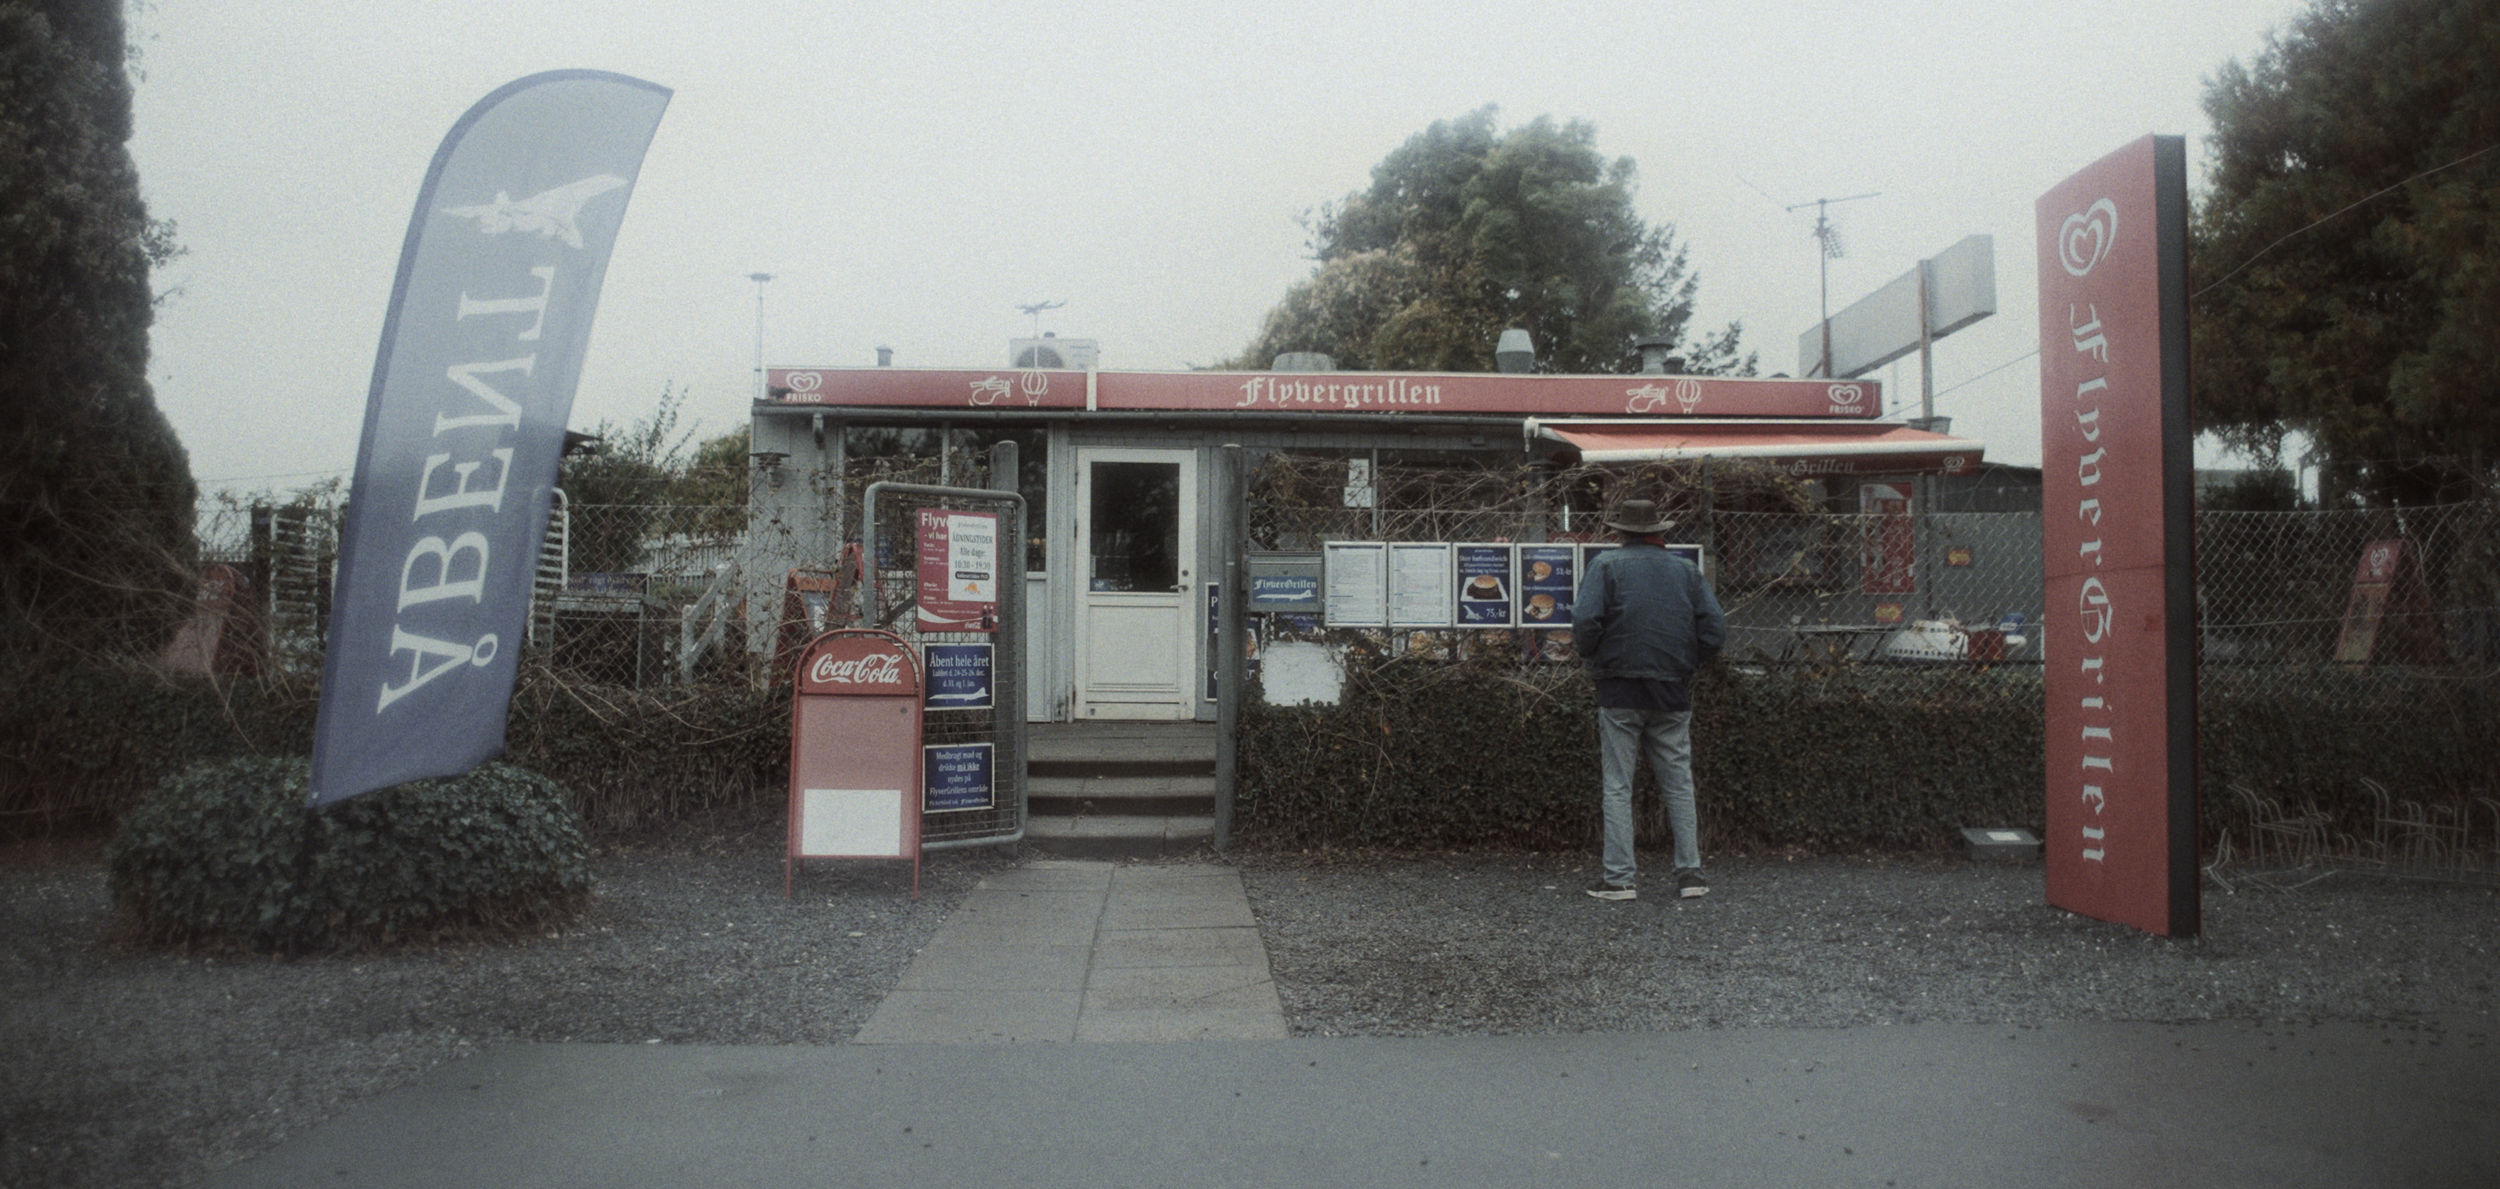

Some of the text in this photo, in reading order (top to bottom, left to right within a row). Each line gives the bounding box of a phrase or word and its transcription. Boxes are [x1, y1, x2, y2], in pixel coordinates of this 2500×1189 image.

[786, 393, 822, 403] FRISKO
[1236, 376, 1441, 409] Flyvergrillen
[1829, 405, 1863, 414] FRISKO
[952, 532, 993, 544] ÅBNINGSTIDER
[2068, 301, 2116, 866] FlyverGrillen
[930, 652, 989, 667] Åbent hele året
[811, 653, 904, 684] Coca-Cola
[936, 750, 983, 761] Medbragt mad og
[938, 763, 956, 772] drikke
[947, 774, 964, 785] nydes
